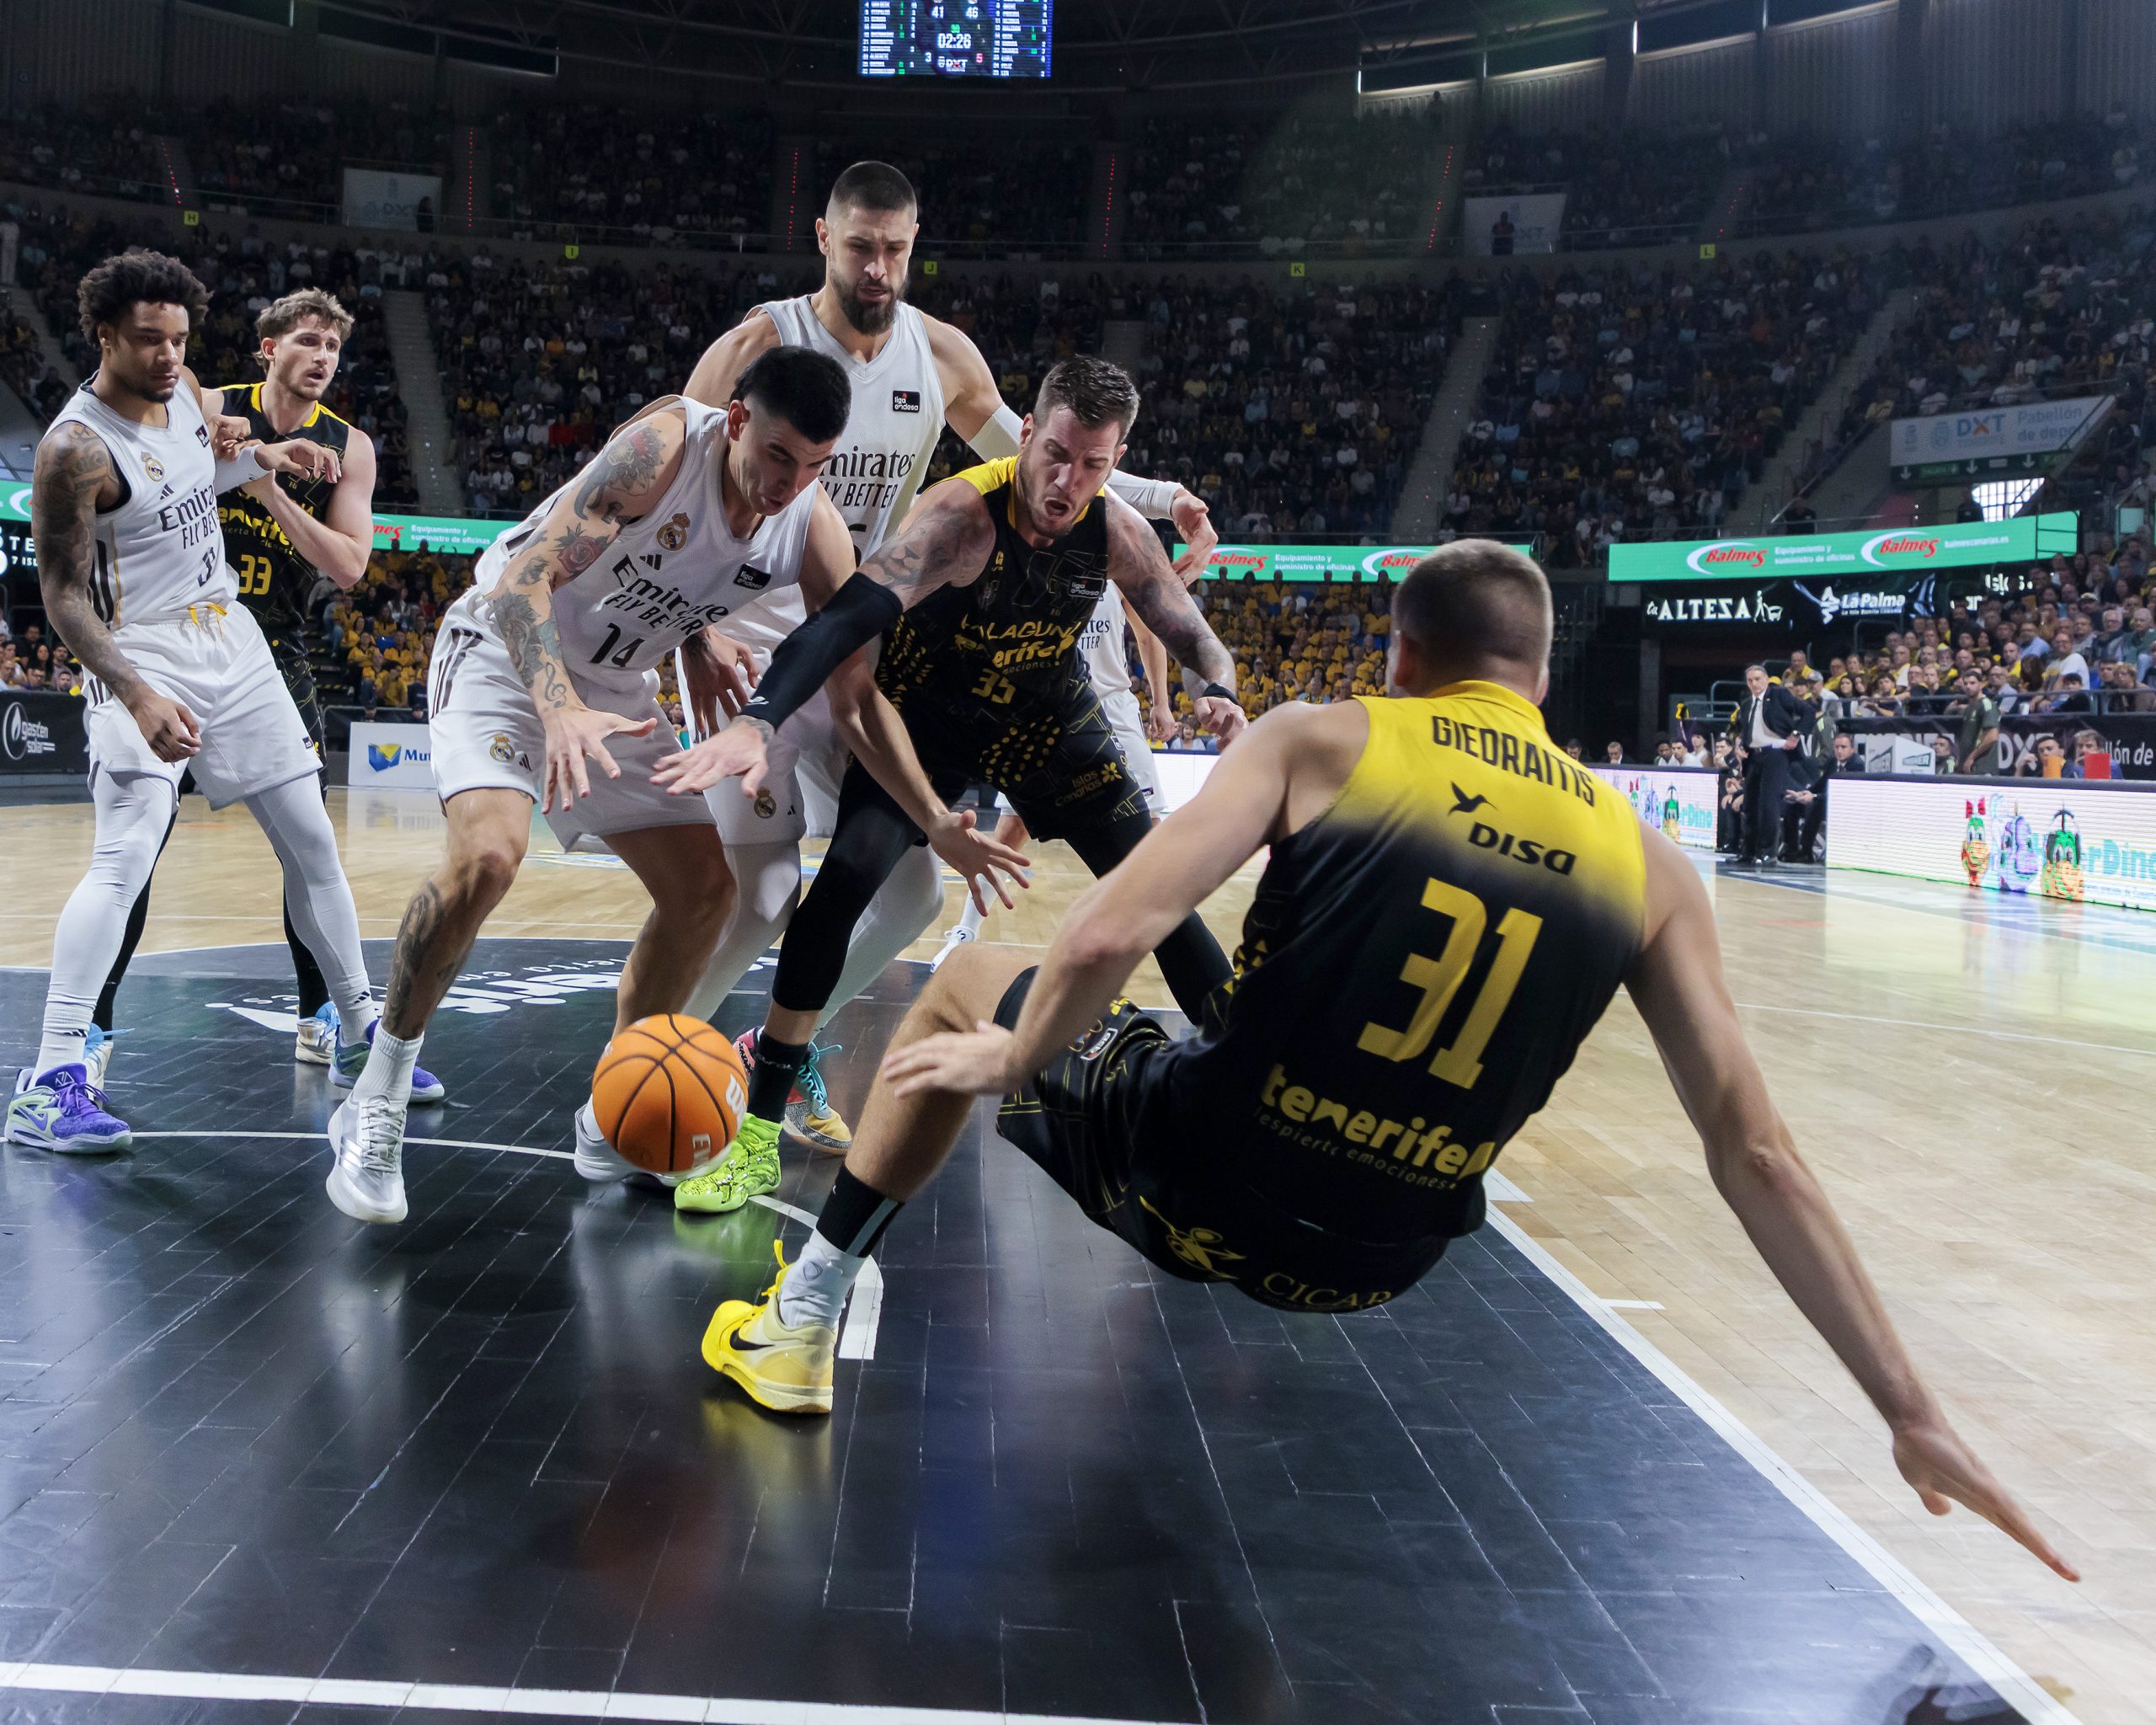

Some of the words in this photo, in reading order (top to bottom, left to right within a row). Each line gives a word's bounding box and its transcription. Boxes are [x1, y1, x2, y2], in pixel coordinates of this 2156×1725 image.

[1956, 414, 2006, 437] DXT
[843, 482, 898, 508] BETTER
[411, 524, 461, 534] Equipamiento
[462, 537, 491, 545] oficinas
[1879, 537, 1940, 558] Balmes
[1209, 553, 1268, 571] Balmes
[1275, 554, 1326, 563] Equipamiento
[1705, 547, 1768, 567] Balmes
[239, 553, 272, 595] 33
[605, 594, 646, 612] FLY
[1841, 594, 1860, 608] La
[1860, 591, 1906, 608] Palma
[590, 622, 646, 667] 14
[1432, 715, 1595, 808] GIEDRAITIS
[2133, 742, 2153, 766] de
[1072, 770, 1098, 788] Islas
[1054, 779, 1102, 806] Canarias
[1357, 877, 1543, 1090] 31
